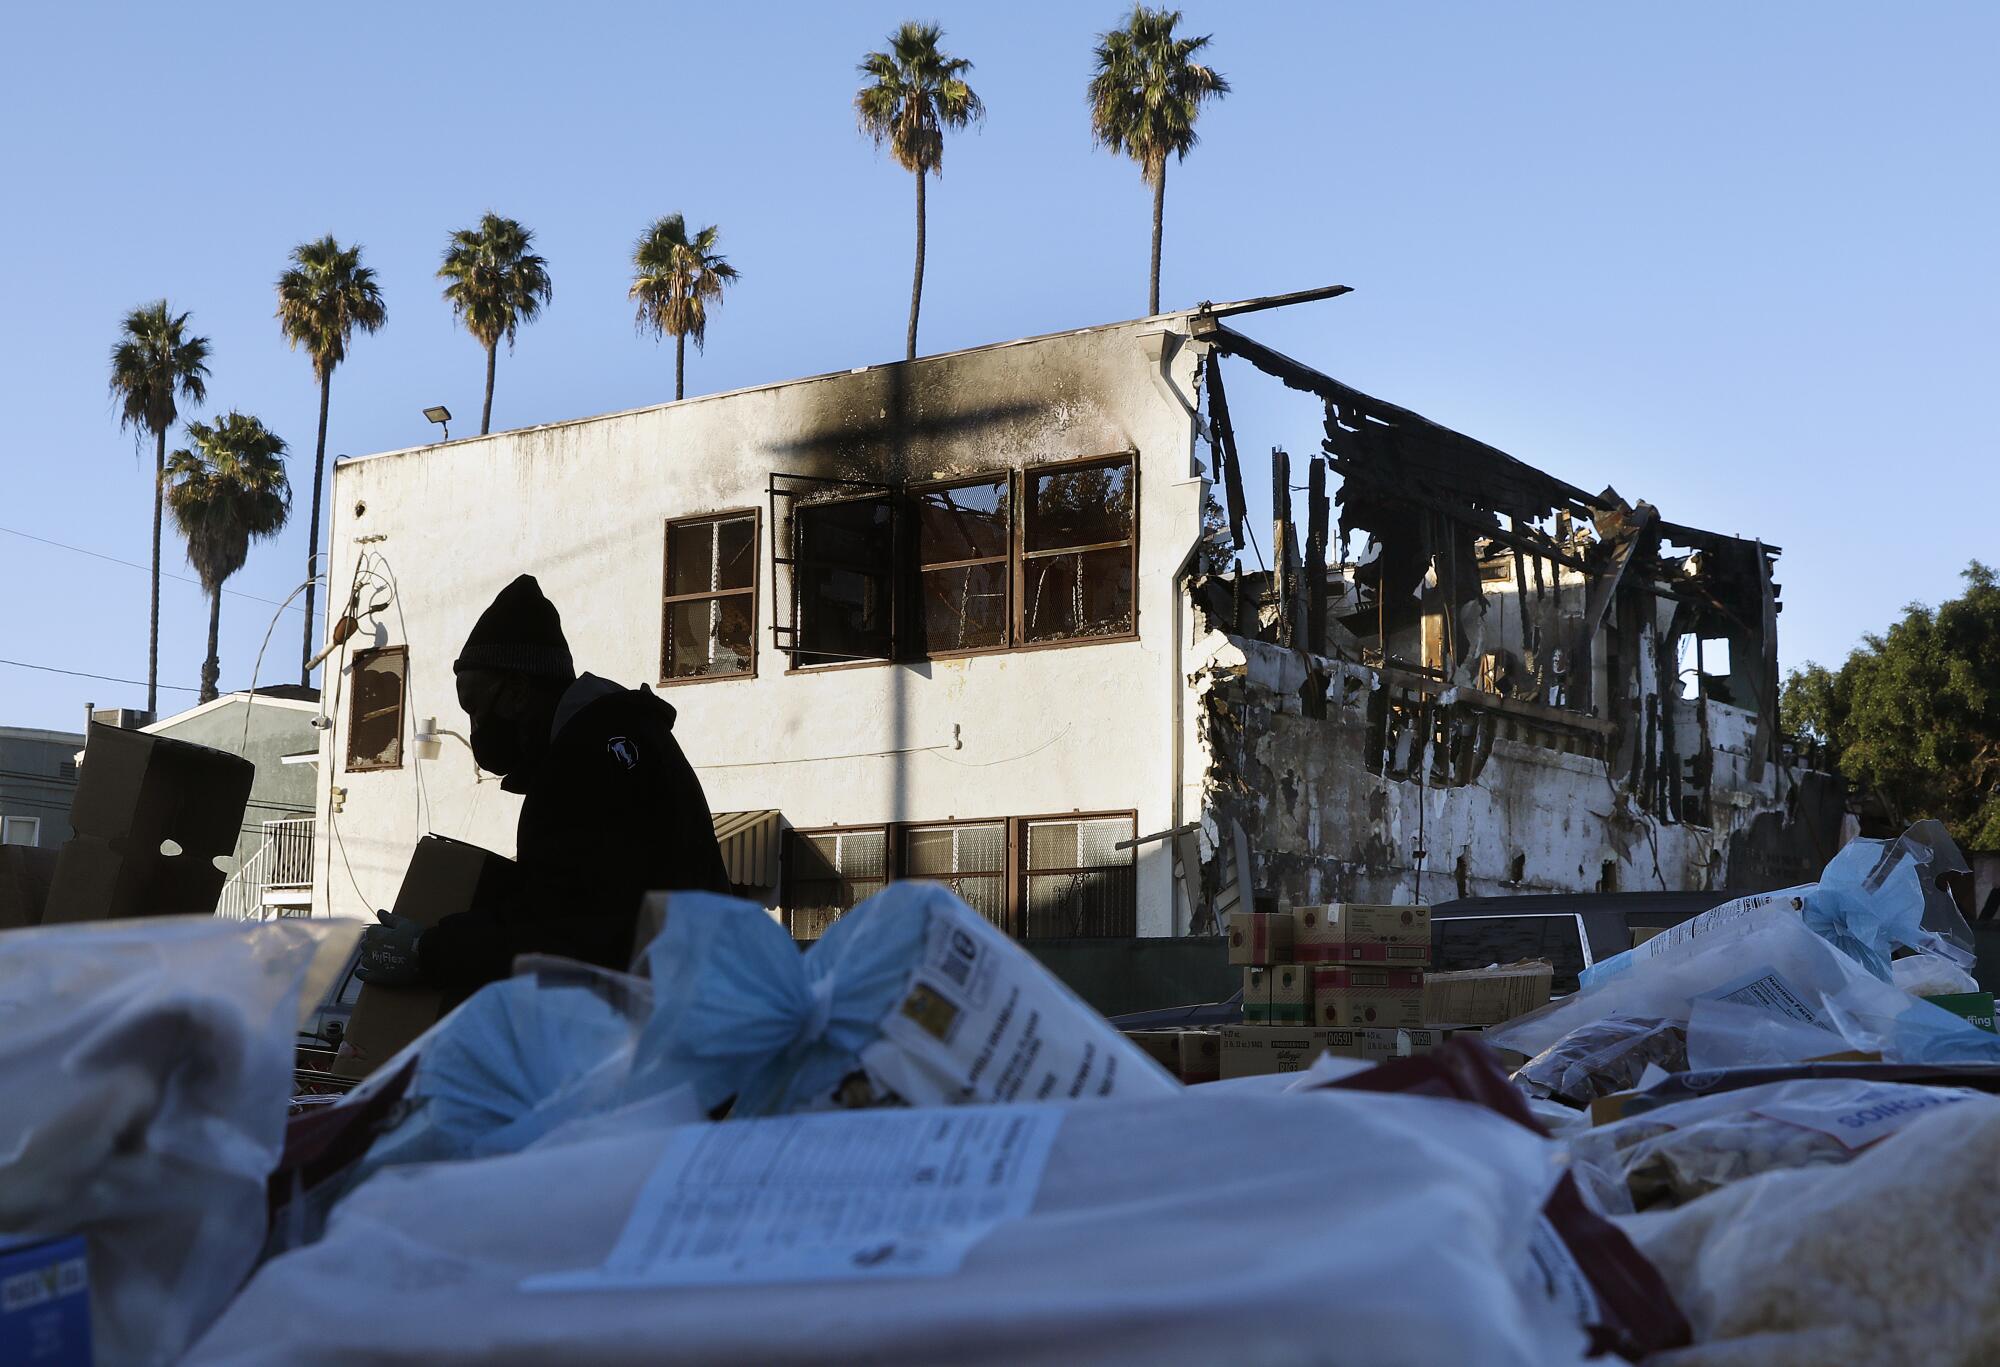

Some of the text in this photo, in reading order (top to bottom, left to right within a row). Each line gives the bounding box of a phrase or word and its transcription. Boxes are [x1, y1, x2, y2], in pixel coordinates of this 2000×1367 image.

[1768, 977, 1795, 1004] Nutrition
[1967, 1015, 1991, 1027] ffing
[1328, 1032, 1351, 1046] 00591
